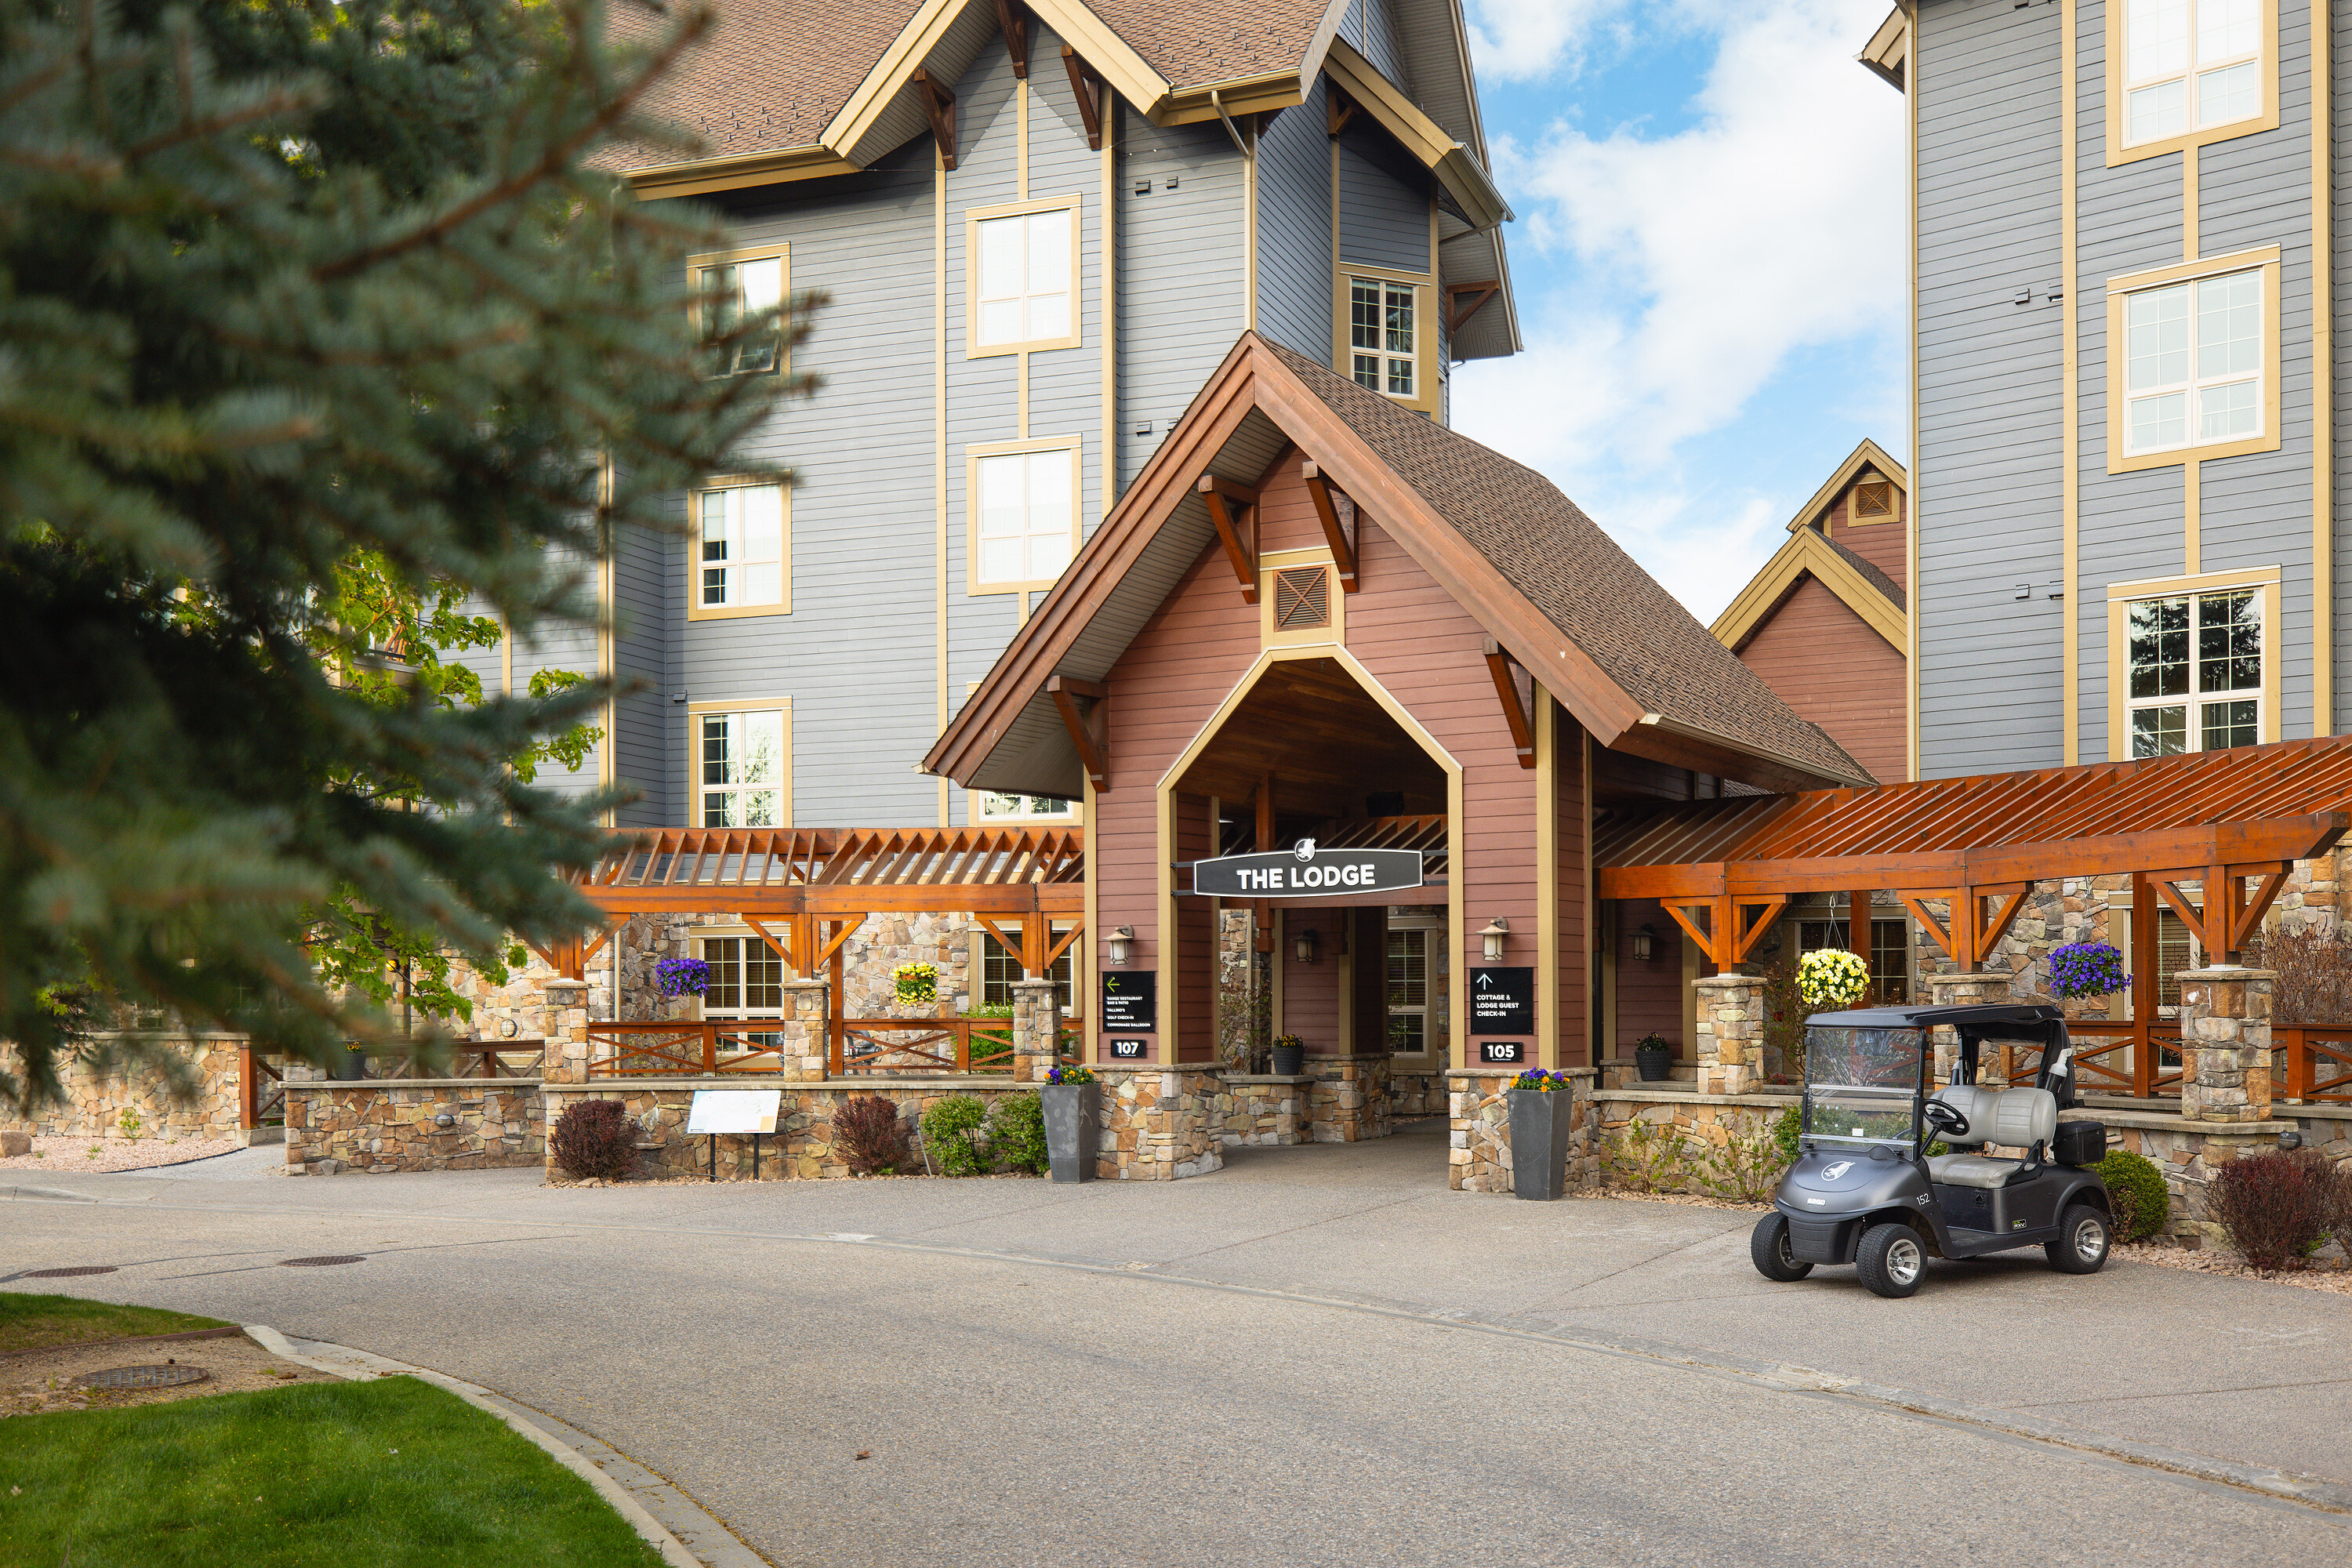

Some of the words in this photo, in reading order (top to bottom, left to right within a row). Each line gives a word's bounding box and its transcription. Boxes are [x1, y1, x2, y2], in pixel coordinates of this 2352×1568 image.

[1236, 868, 1284, 890] THE
[1290, 864, 1376, 888] LODGE
[1116, 1042, 1139, 1054] 107
[1487, 1044, 1515, 1058] 105
[1916, 1193, 1929, 1206] 152
